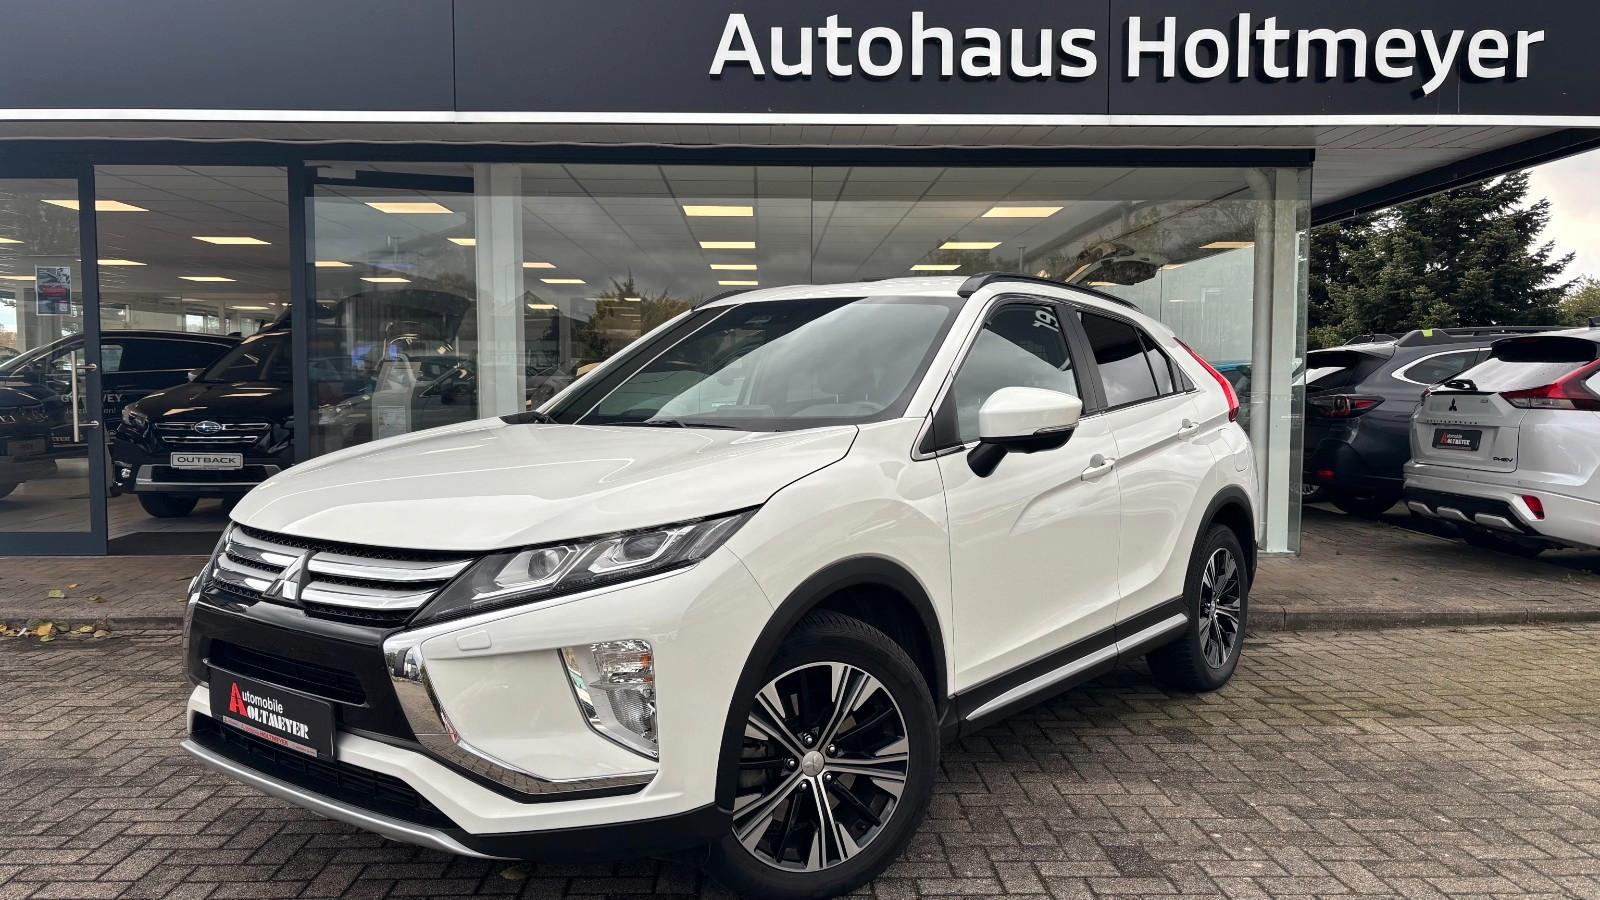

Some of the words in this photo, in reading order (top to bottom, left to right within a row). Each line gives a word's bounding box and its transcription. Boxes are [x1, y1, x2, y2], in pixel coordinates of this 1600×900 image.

[709, 12, 1098, 78] Autohaus
[1127, 13, 1545, 95] Holtmeyer
[177, 456, 237, 464] OUTBACK
[229, 682, 284, 716] Automobile
